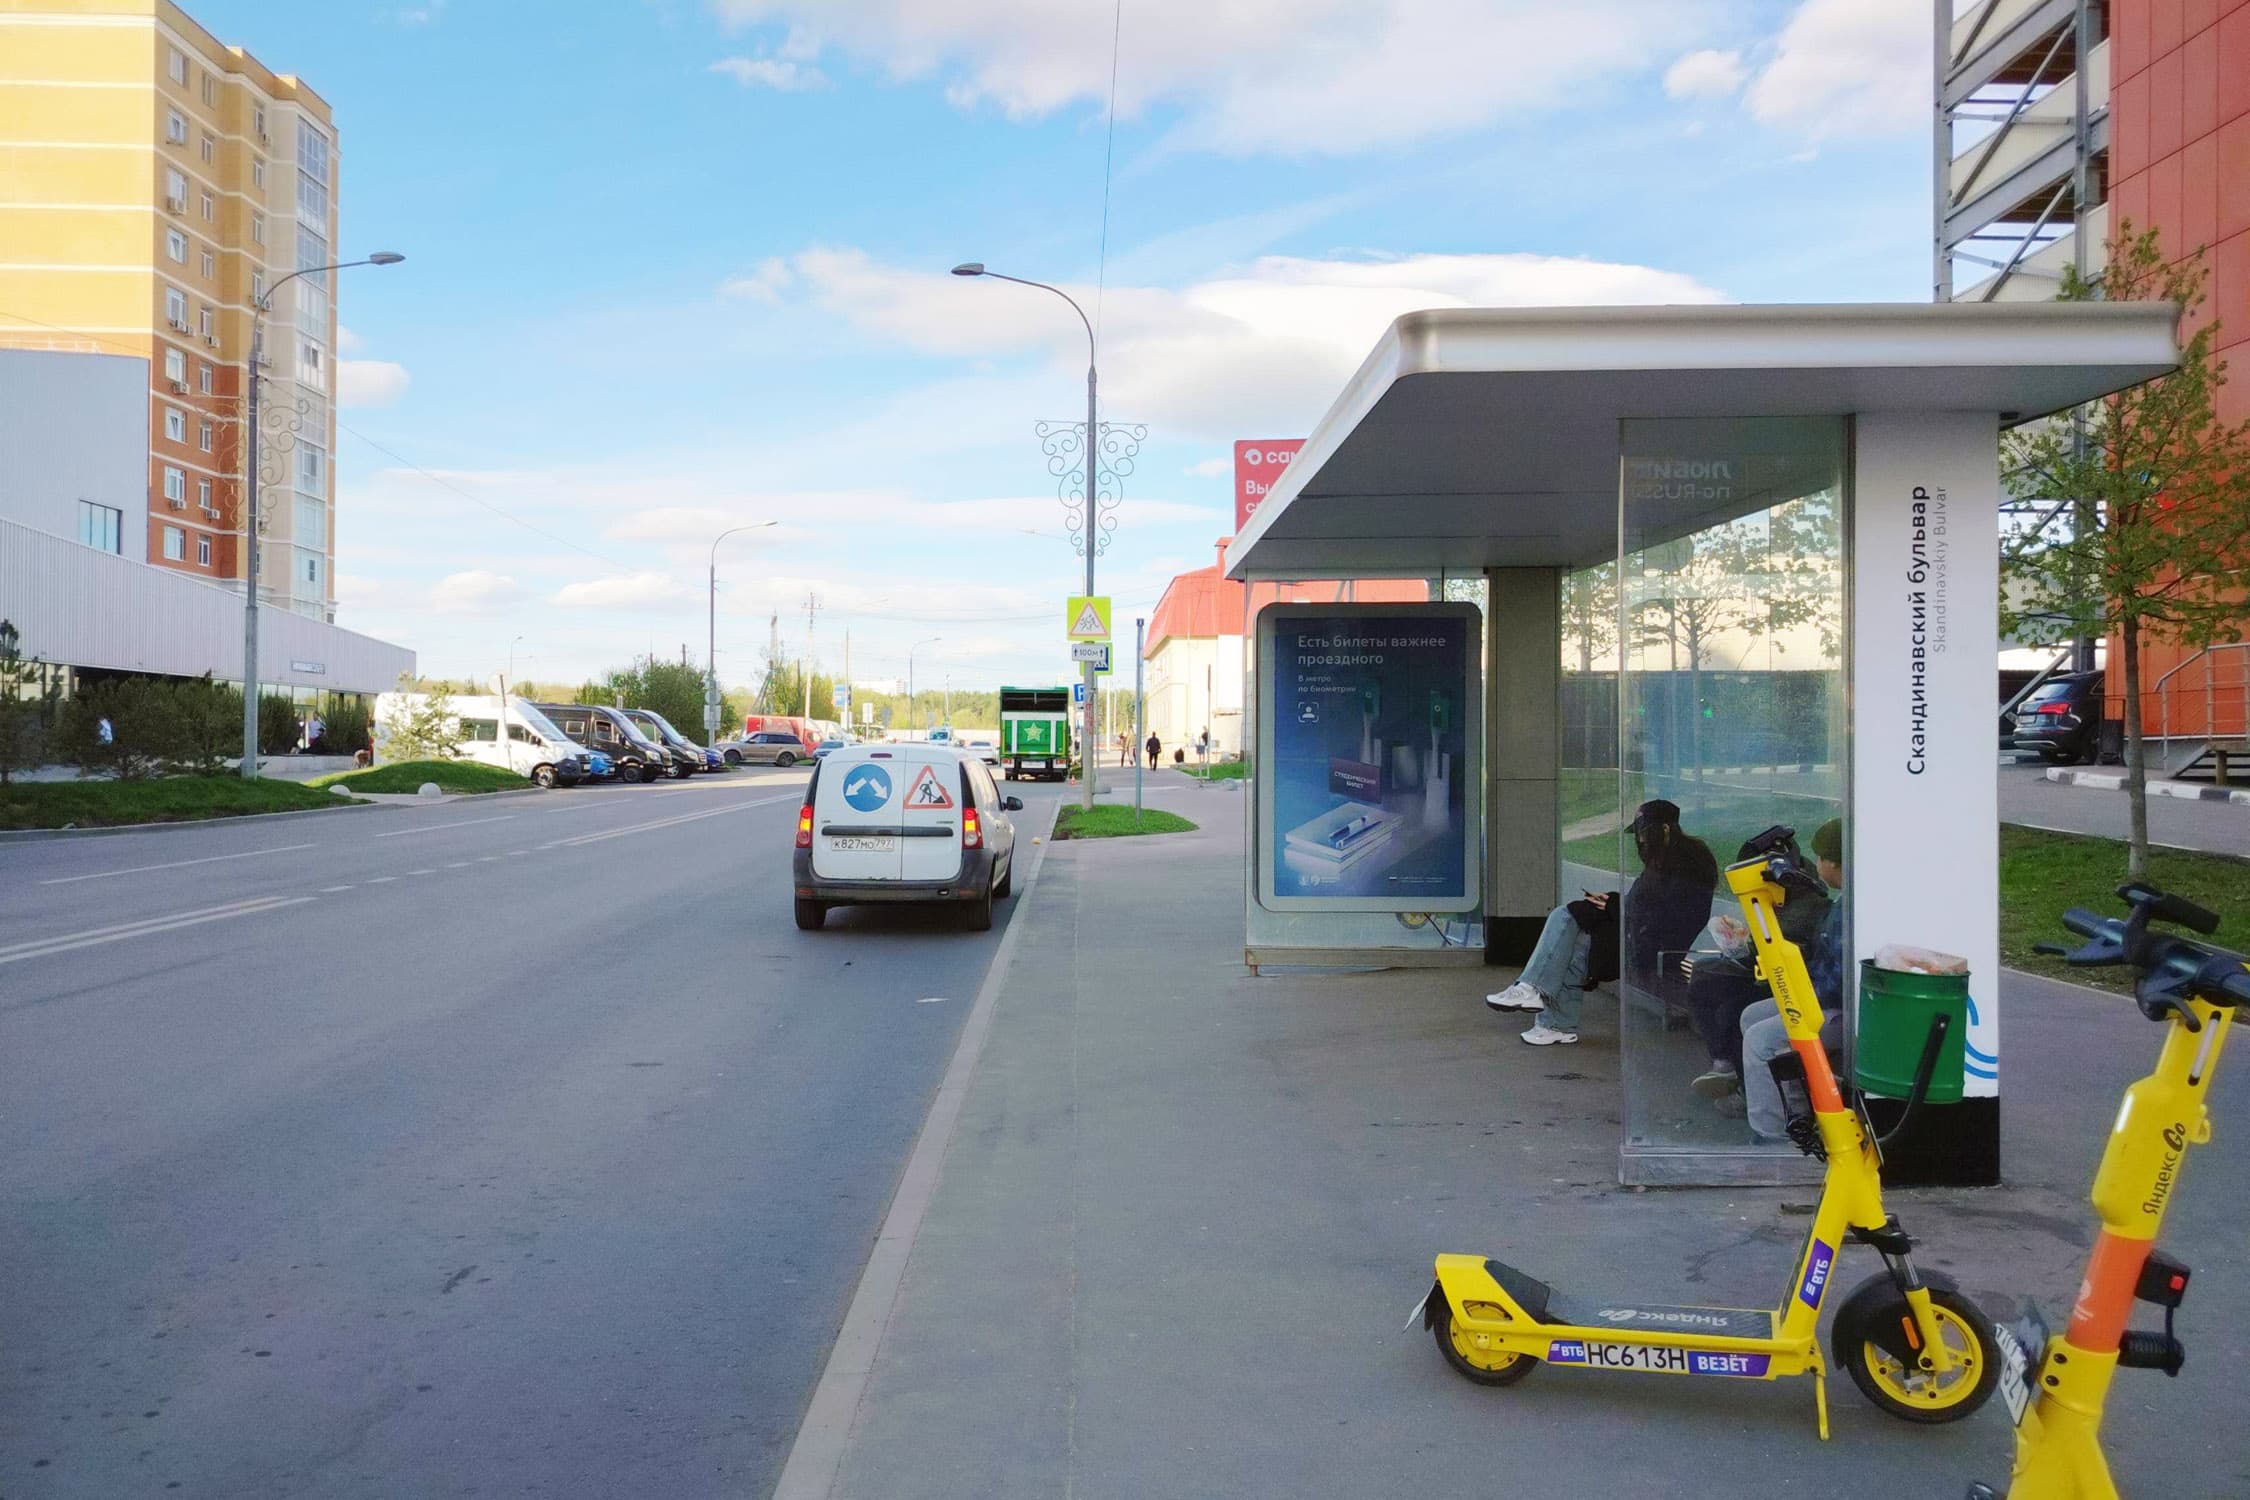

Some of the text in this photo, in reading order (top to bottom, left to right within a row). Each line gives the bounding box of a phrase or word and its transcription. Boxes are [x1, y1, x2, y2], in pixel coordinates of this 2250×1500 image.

[1933, 486, 1948, 653] Skandinavskiy Bulvar
[1298, 635, 1447, 648] Есть билеты важнее
[1907, 486, 1930, 775] Скандинавский бульвар
[1298, 655, 1384, 668] проездного
[1773, 966, 1793, 1008] Яндекс
[2142, 1122, 2186, 1215] Яндекс Go
[1811, 1259, 1829, 1285] ВТБ
[1638, 1310, 1728, 1327] Яндекс
[1561, 1345, 1585, 1358] ВТБ
[1697, 1353, 1750, 1373] ВЕЗЁТ
